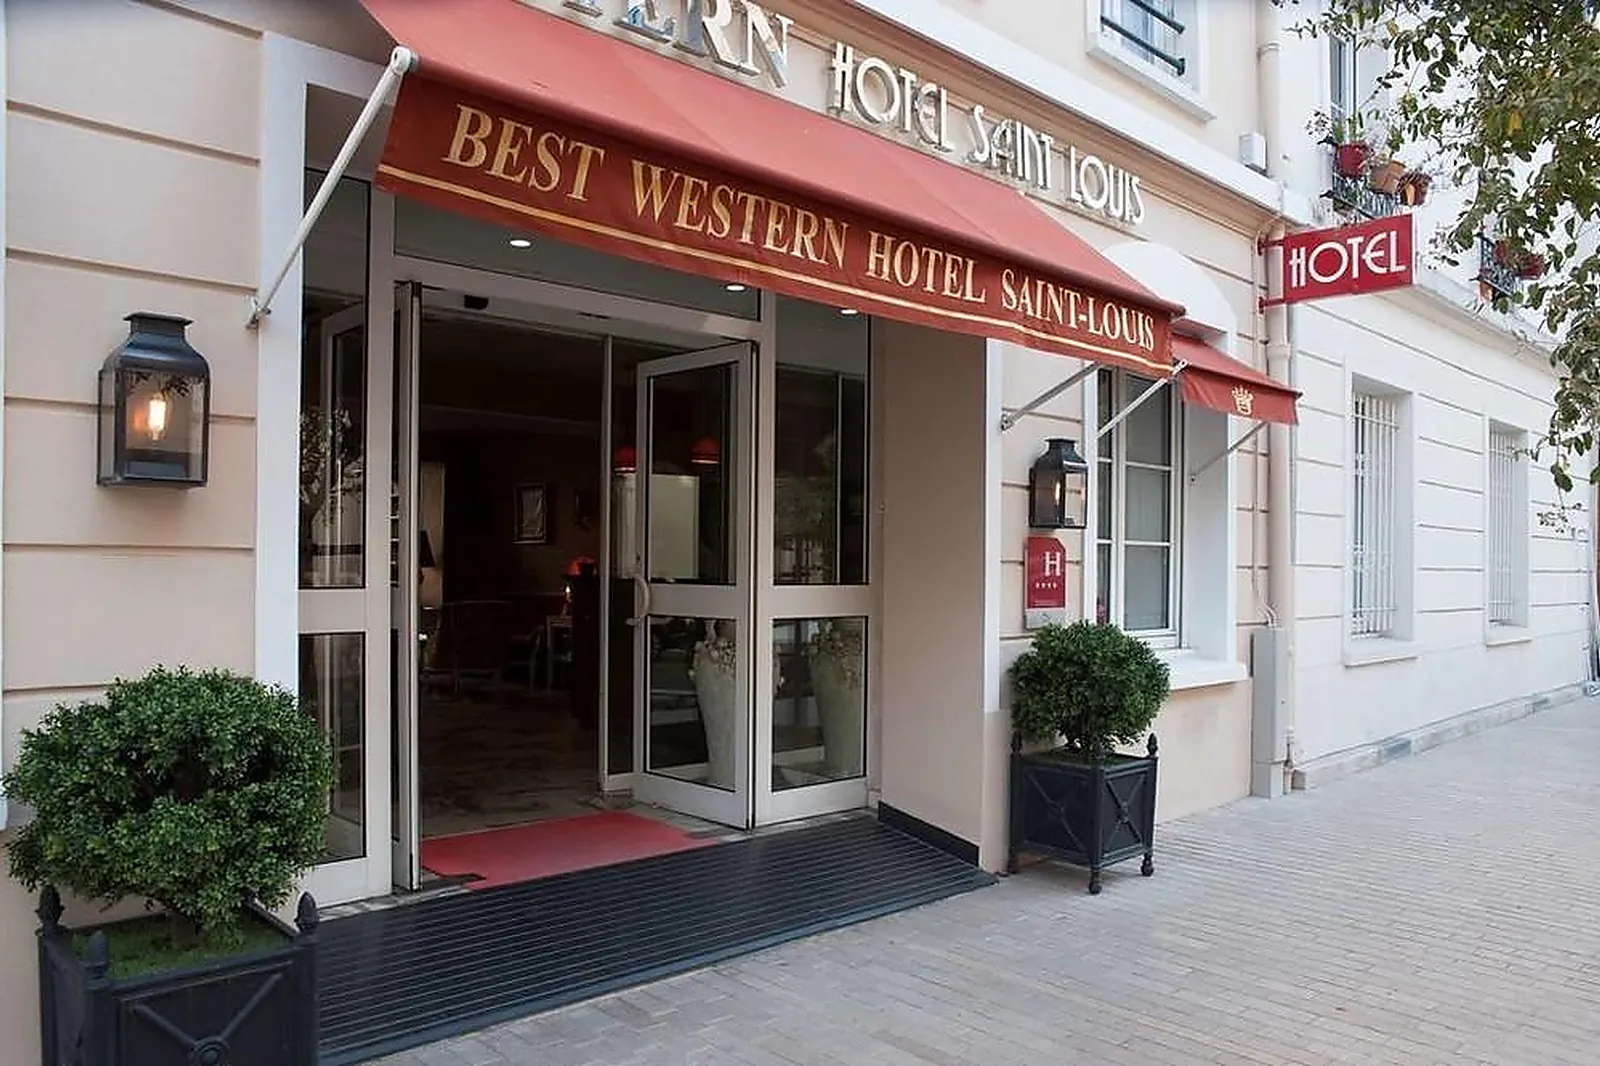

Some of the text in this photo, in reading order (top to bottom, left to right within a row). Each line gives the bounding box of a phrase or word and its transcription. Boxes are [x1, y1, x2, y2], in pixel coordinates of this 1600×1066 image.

[831, 41, 954, 151] HOTEL
[971, 104, 1055, 189] SAINT
[1070, 145, 1146, 225] LOUIS
[441, 103, 1155, 352] BEST WESTERN HOTEL SAINT-LOUIS
[1289, 230, 1406, 288] HOTEL
[1044, 551, 1062, 577] H
